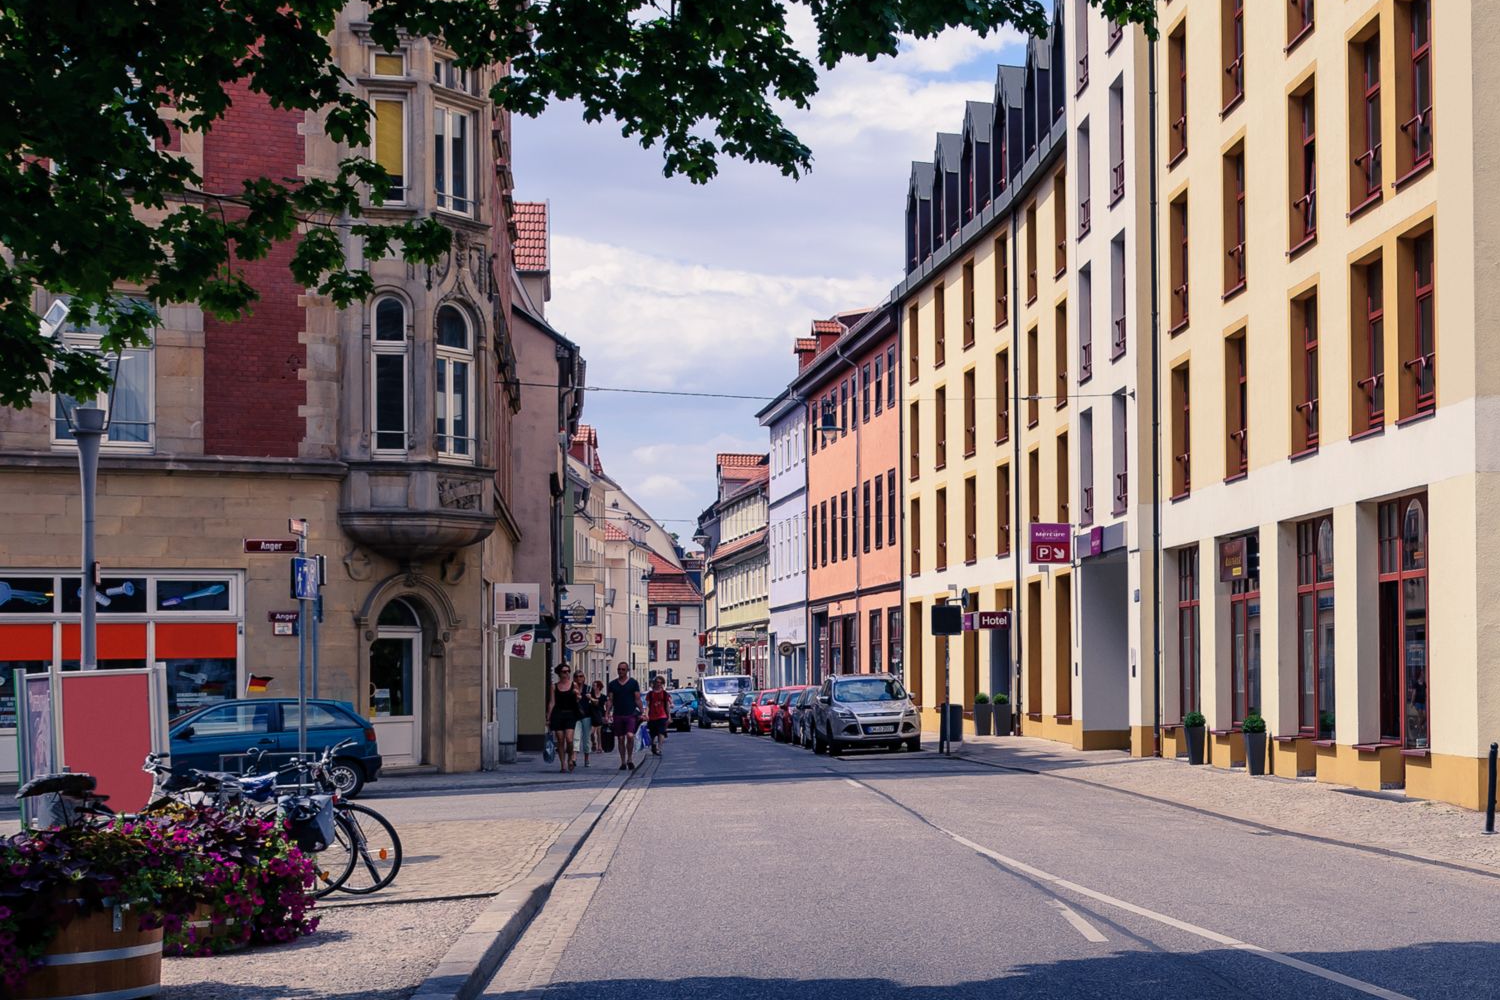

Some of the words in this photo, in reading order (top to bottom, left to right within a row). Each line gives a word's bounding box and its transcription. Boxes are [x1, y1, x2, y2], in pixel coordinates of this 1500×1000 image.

[260, 542, 282, 552] Anger
[1040, 548, 1049, 558] P
[275, 612, 297, 620] Anger
[982, 616, 1008, 625] Hotel
